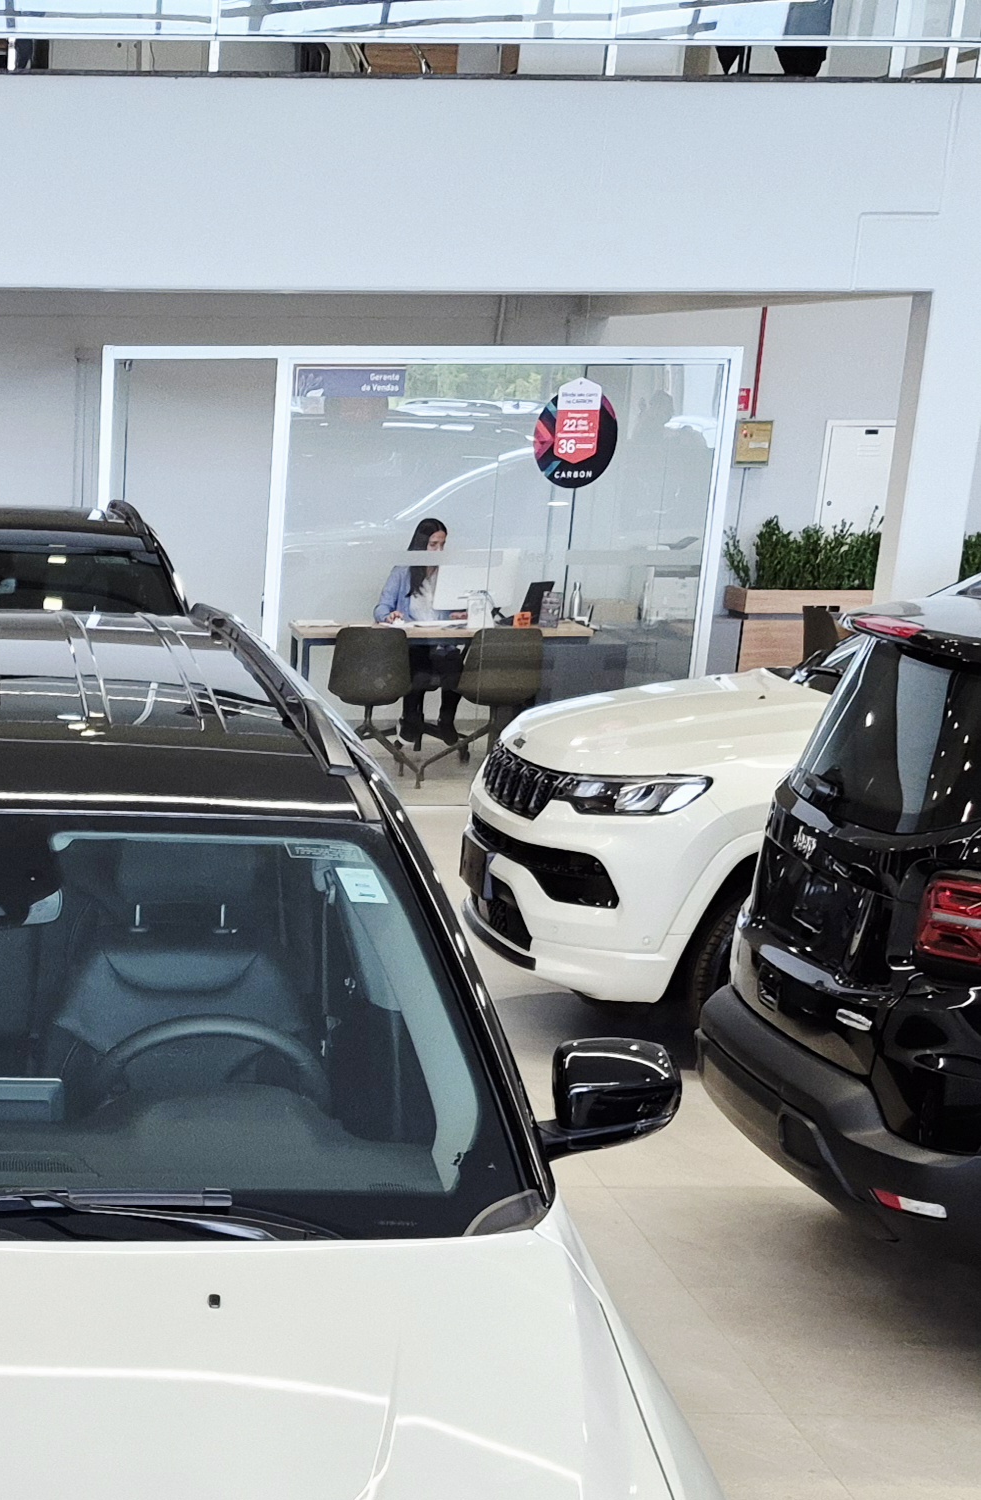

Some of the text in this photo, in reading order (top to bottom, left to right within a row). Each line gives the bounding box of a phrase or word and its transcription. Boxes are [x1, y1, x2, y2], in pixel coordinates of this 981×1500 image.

[369, 373, 400, 381] Gerente
[372, 383, 399, 392] Vendas
[563, 419, 576, 431] 22
[558, 439, 576, 454] 36
[554, 470, 593, 479] CARBON
